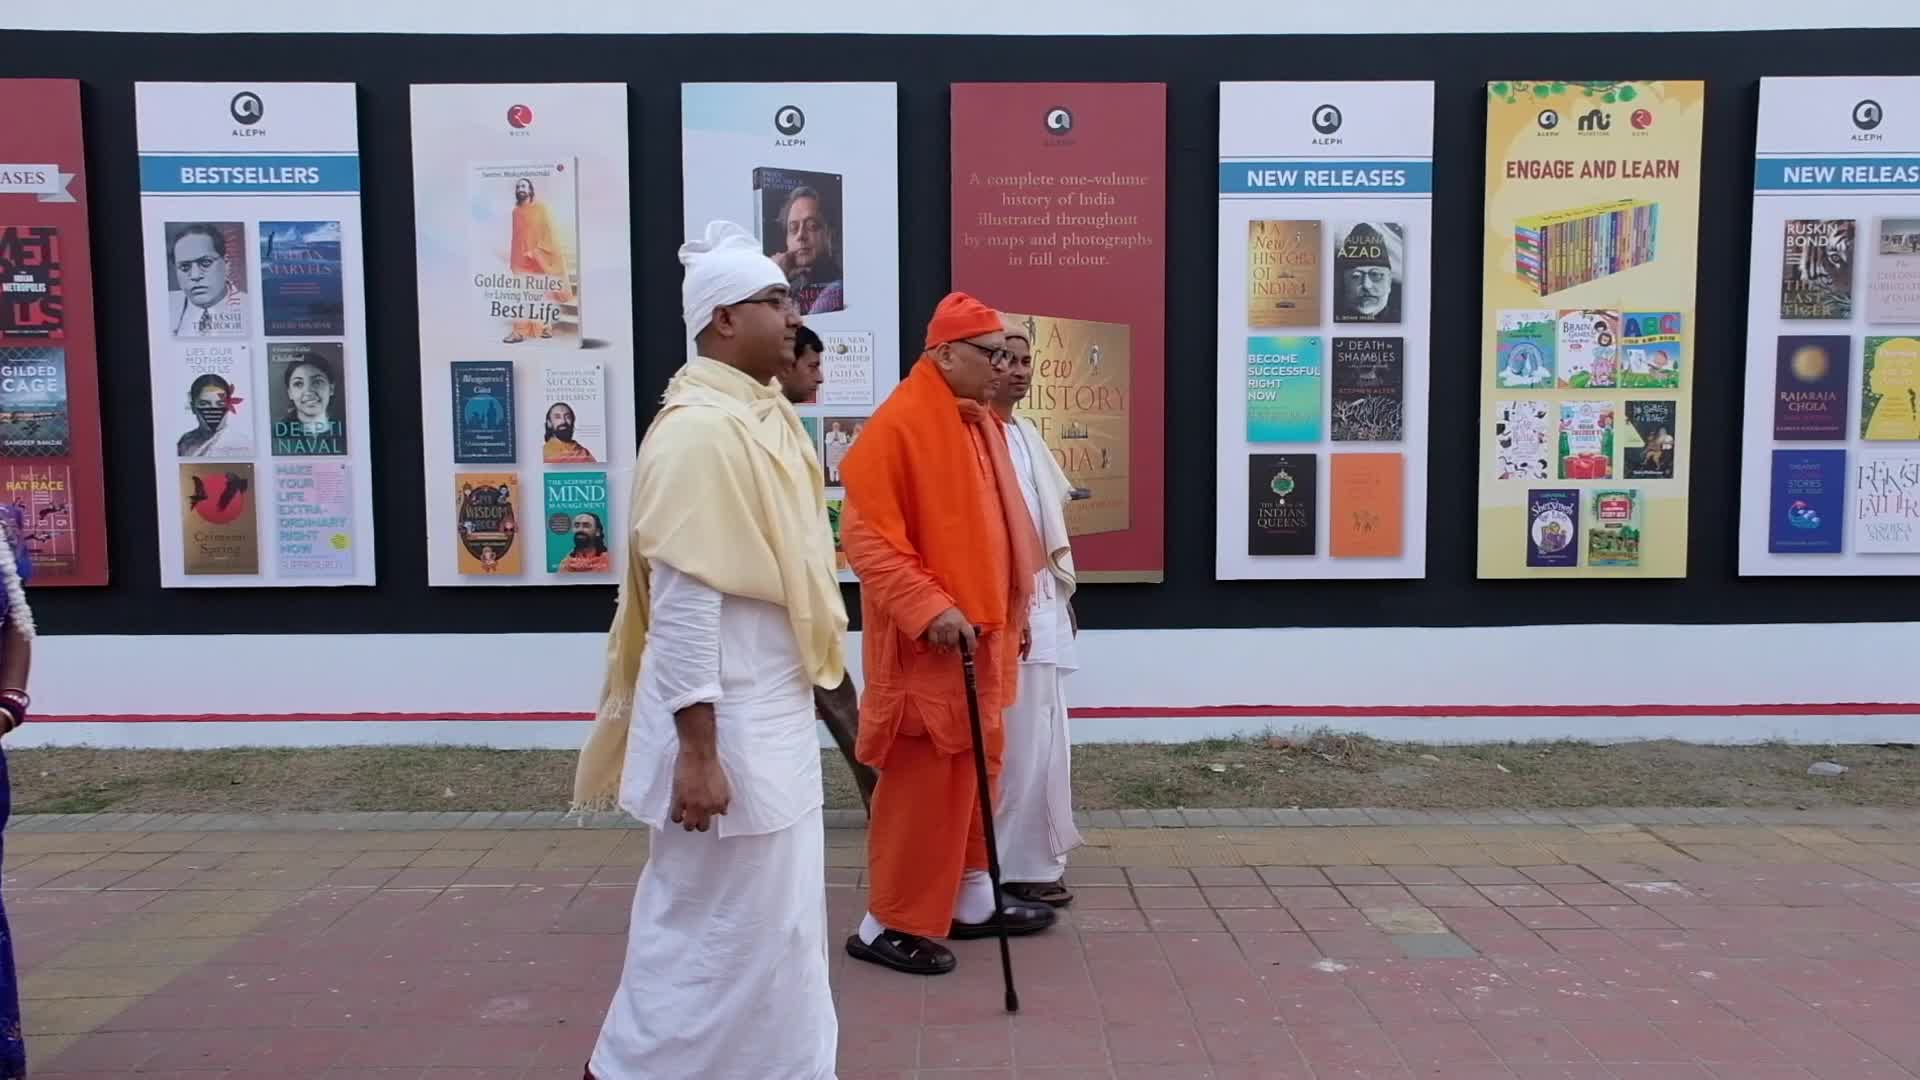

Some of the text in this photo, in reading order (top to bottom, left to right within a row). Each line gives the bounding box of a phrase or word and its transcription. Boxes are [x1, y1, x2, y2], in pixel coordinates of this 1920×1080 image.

[775, 139, 806, 147] ALEPH
[1506, 160, 1680, 179] ENGAGE AND LEARN
[1784, 165, 1920, 183] NEW RELEAS
[181, 168, 320, 184] BESTSELLERS
[969, 172, 1149, 189] A complete one-volume
[1247, 170, 1406, 187] NEW RELEASES
[1002, 192, 1115, 209] history of India
[978, 212, 1138, 229] illustrated throughout
[1787, 223, 1838, 235] RUSKIN
[964, 232, 1153, 249] by maps and photographs
[1787, 236, 1828, 247] BOND
[1337, 246, 1381, 258] AZAD
[1008, 251, 1110, 266] in full colour.
[474, 273, 563, 291] Golden Rules
[522, 291, 543, 301] Your
[1784, 292, 1824, 303] LAST
[490, 301, 560, 325] Best Life
[1563, 322, 1591, 333] BRAIN
[1047, 324, 1064, 348] A
[1349, 340, 1384, 349] DEATH
[1249, 354, 1297, 363] BECOME
[1338, 352, 1395, 362] SHAMBLES
[1, 366, 56, 376] GILDED
[1248, 367, 1320, 376] SUCCESSFUL
[2, 379, 57, 392] CAGE
[1248, 379, 1281, 388] RIGHT
[1016, 384, 1126, 411] HISTORY
[1248, 391, 1277, 400] NOW
[1788, 402, 1828, 411] CHOLA
[275, 421, 342, 437] DEEPTI
[278, 440, 341, 453] NAVAL
[6, 481, 64, 490] RAT RACE
[278, 479, 314, 488] YOUR
[550, 486, 605, 502] MIND
[465, 506, 508, 519] WISDOM
[1258, 508, 1305, 518] INDIAN
[1257, 518, 1306, 528] QUEENS
